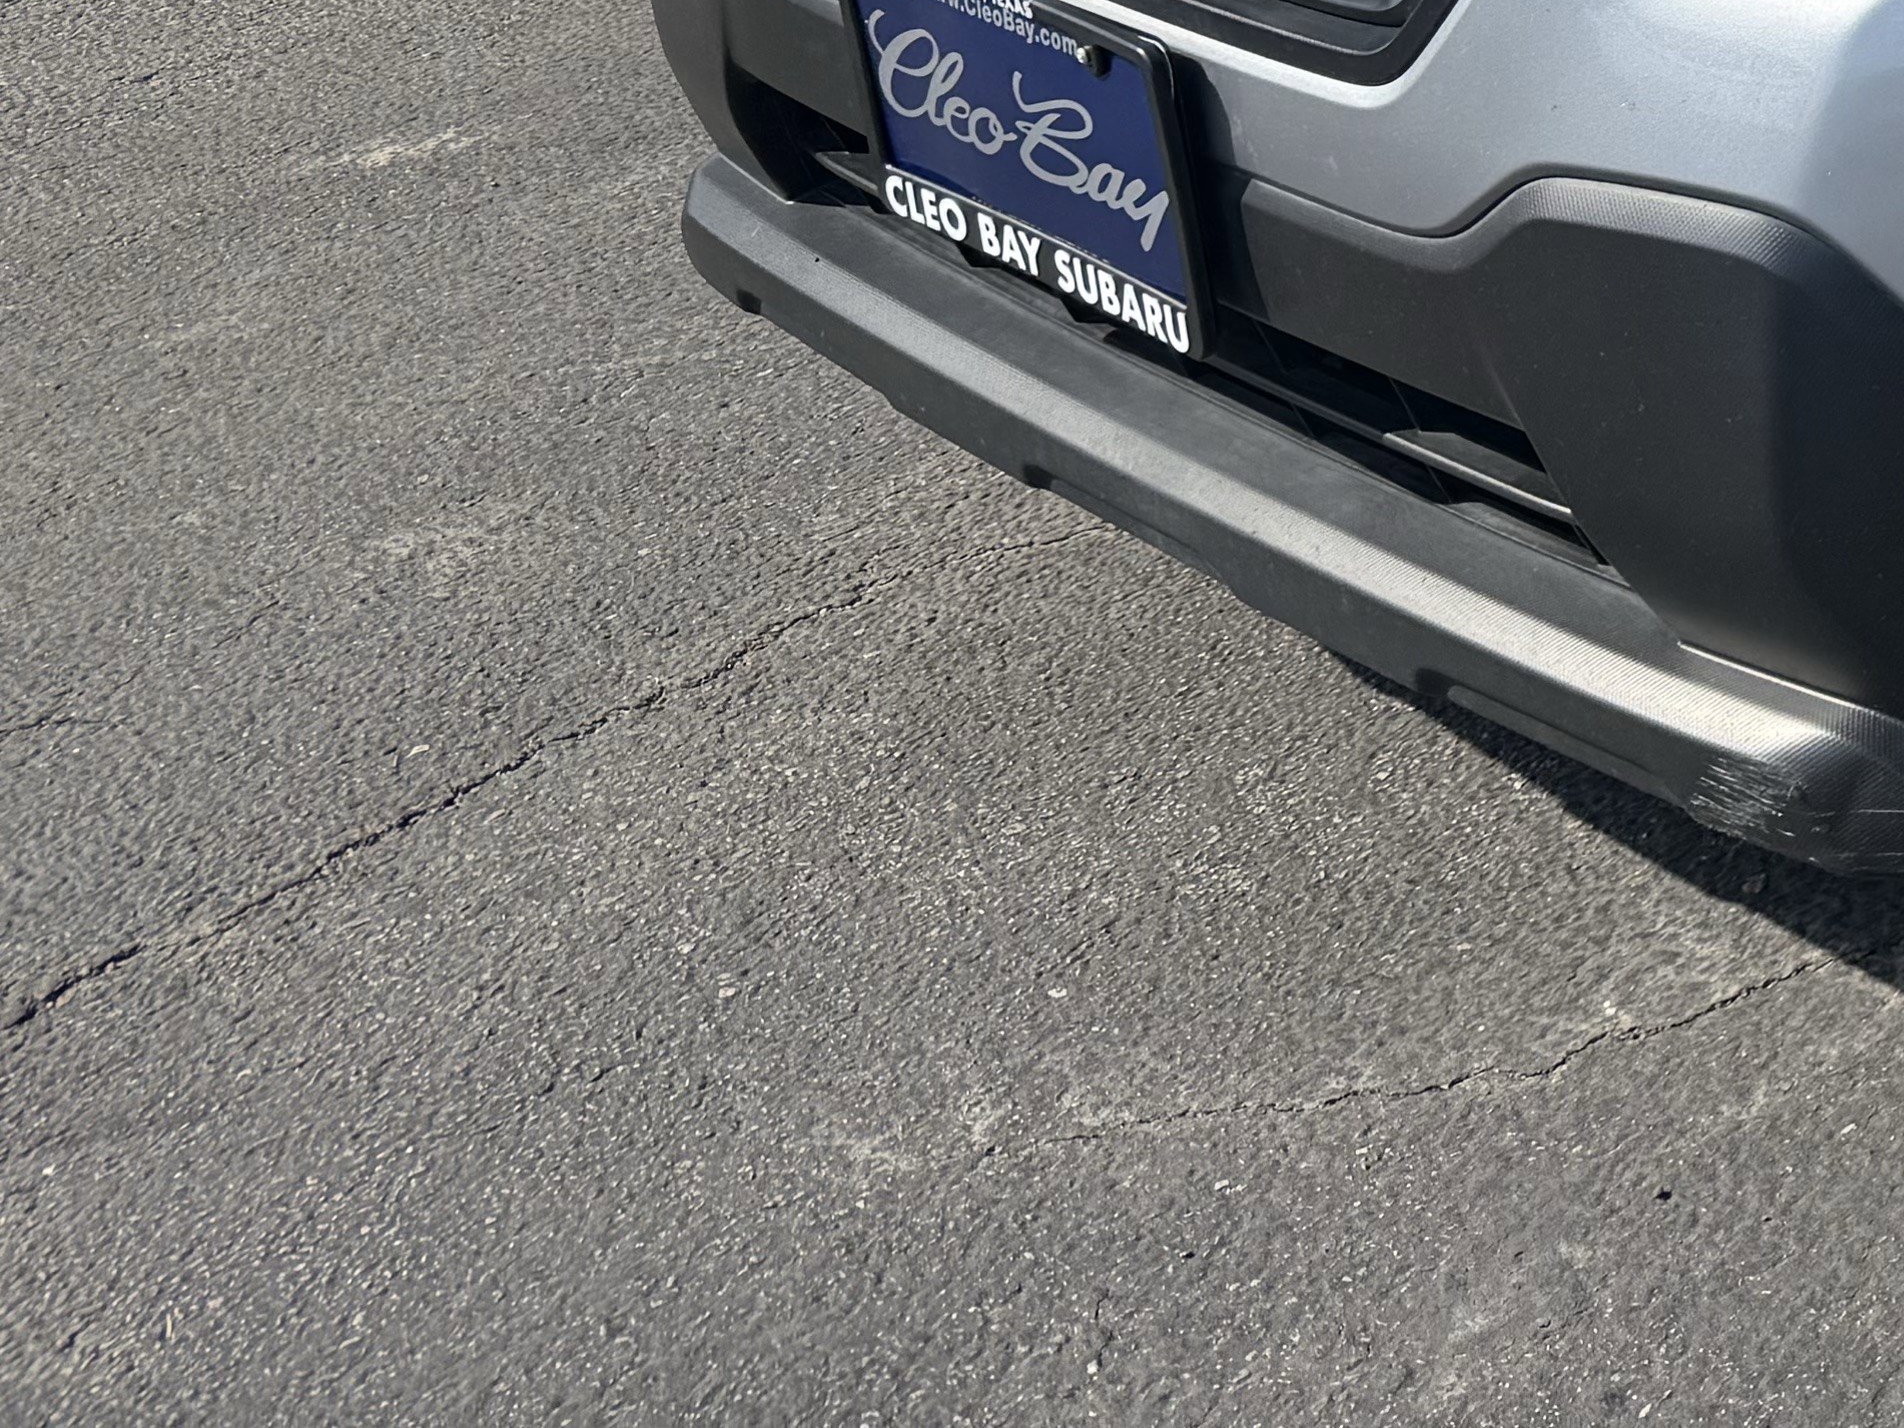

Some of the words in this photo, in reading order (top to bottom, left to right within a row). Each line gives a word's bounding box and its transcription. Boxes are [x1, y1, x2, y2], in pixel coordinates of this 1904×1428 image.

[864, 9, 1017, 155] Cleo
[1013, 70, 1171, 252] Bay
[884, 175, 967, 241] CLEO
[977, 211, 1041, 277] BAY
[1053, 249, 1191, 354] SUBARU
